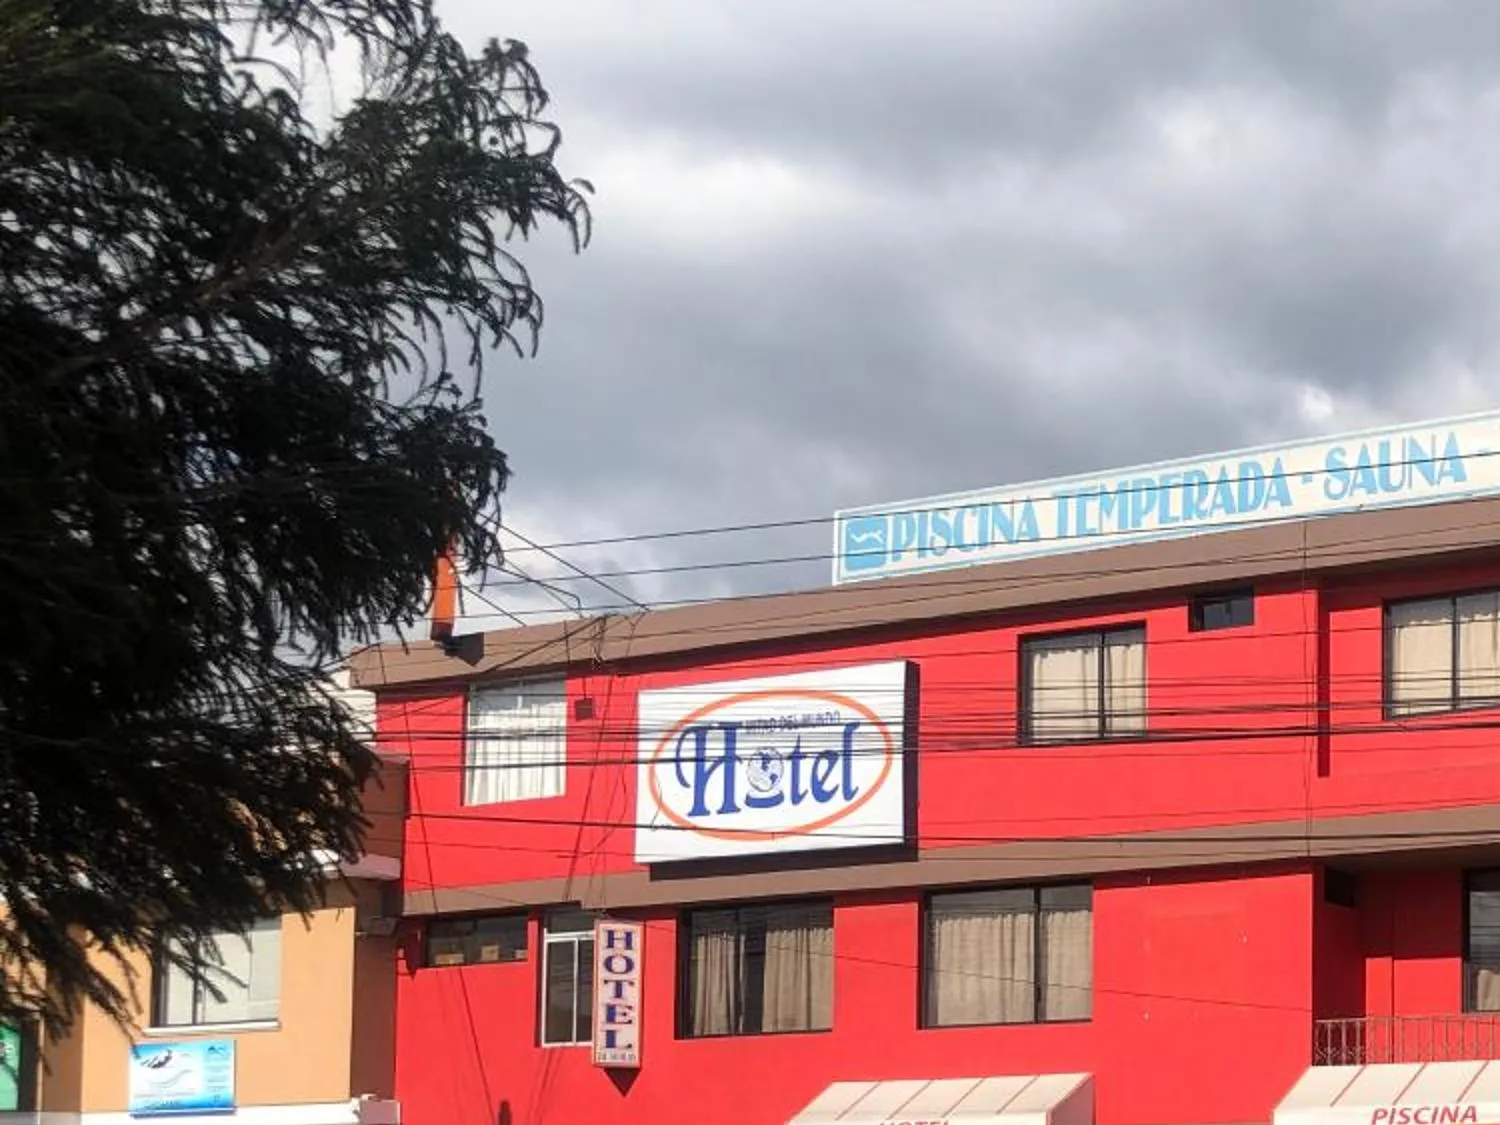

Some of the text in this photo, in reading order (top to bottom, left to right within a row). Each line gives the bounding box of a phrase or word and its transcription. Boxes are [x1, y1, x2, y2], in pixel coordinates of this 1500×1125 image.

[892, 496, 1040, 561] PISCINA
[1052, 456, 1293, 538] TEMPERADA
[1323, 431, 1468, 501] SAUNA
[603, 929, 635, 1049] HOTEL
[1371, 1104, 1478, 1125] PISCINA
